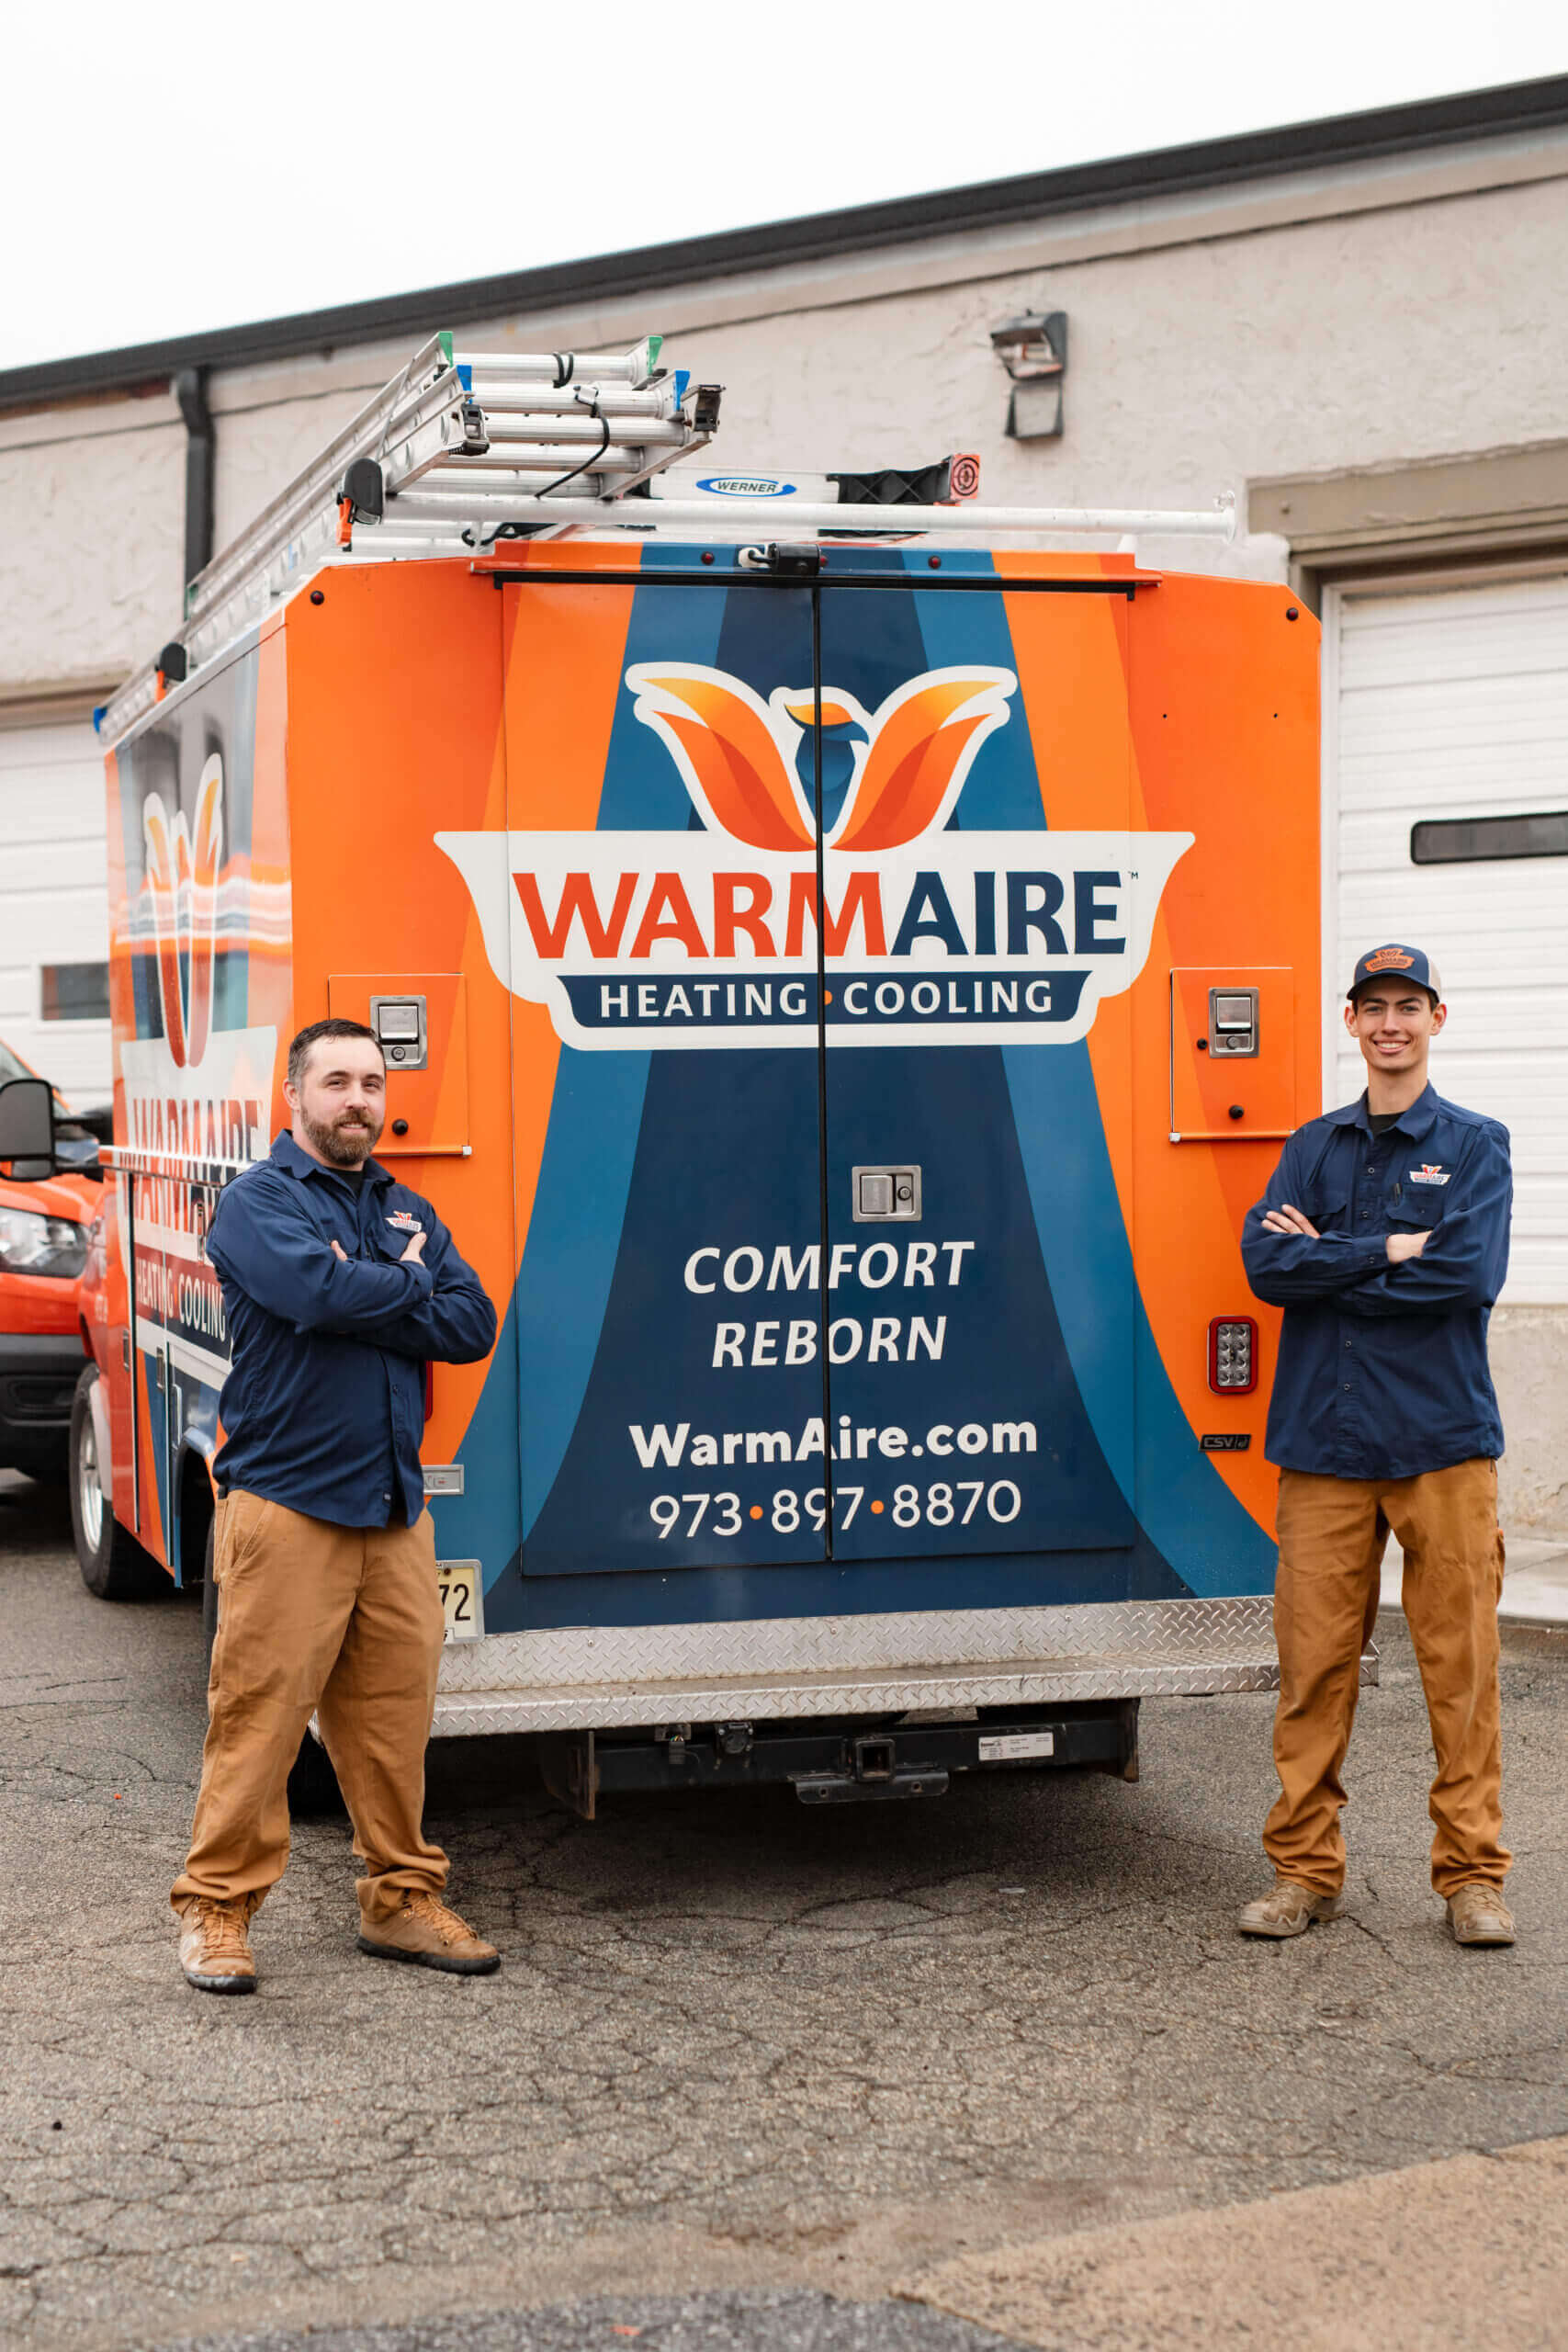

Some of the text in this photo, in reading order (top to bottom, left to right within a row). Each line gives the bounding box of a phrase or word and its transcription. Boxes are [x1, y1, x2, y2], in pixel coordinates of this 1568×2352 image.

[717, 481, 776, 492] WERNER
[512, 871, 1127, 958] WARMAIRE
[601, 979, 1052, 1018] HEATING COOLING
[683, 1241, 975, 1295] COMFORT
[712, 1316, 947, 1368] REBORN
[628, 1415, 1037, 1468] WarmAire.com
